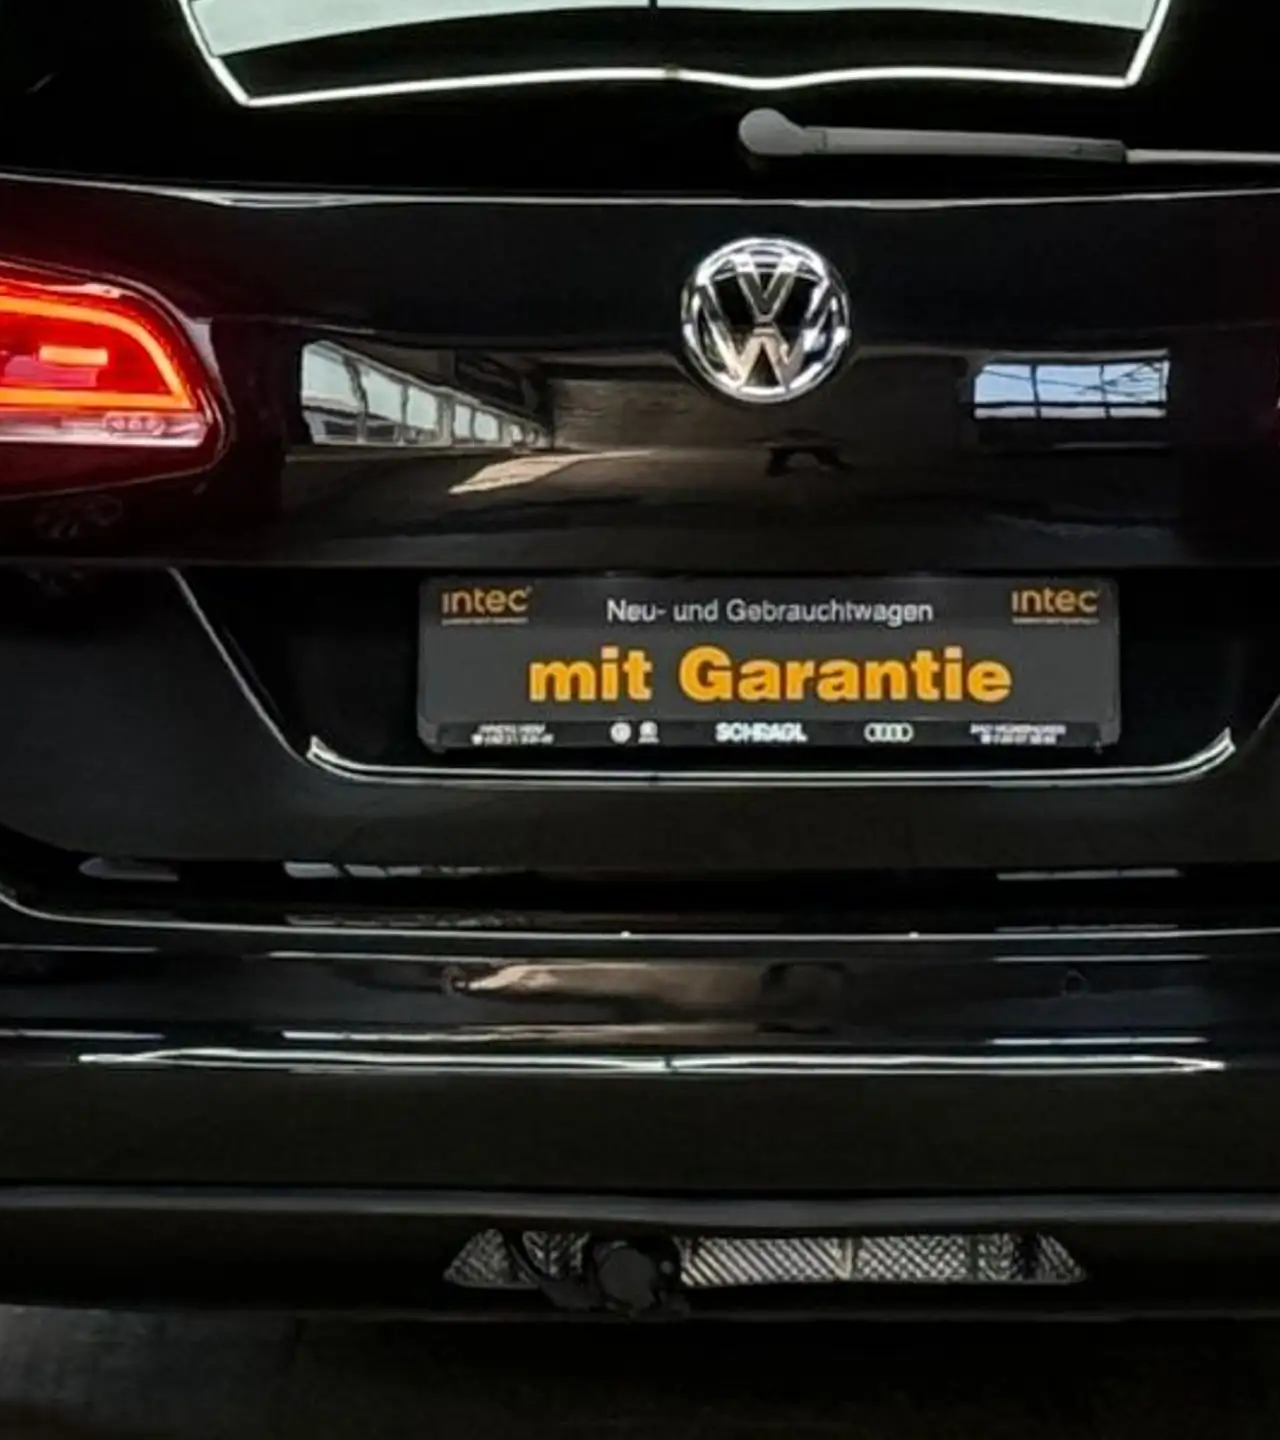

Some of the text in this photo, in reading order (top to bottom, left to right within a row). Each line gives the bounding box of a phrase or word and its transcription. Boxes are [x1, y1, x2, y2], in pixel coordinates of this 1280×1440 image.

[441, 587, 530, 615] intec
[606, 598, 934, 628] Neu- und Gebrauchtwagen
[1011, 587, 1100, 615] intec
[528, 645, 1012, 704] mit Garantie
